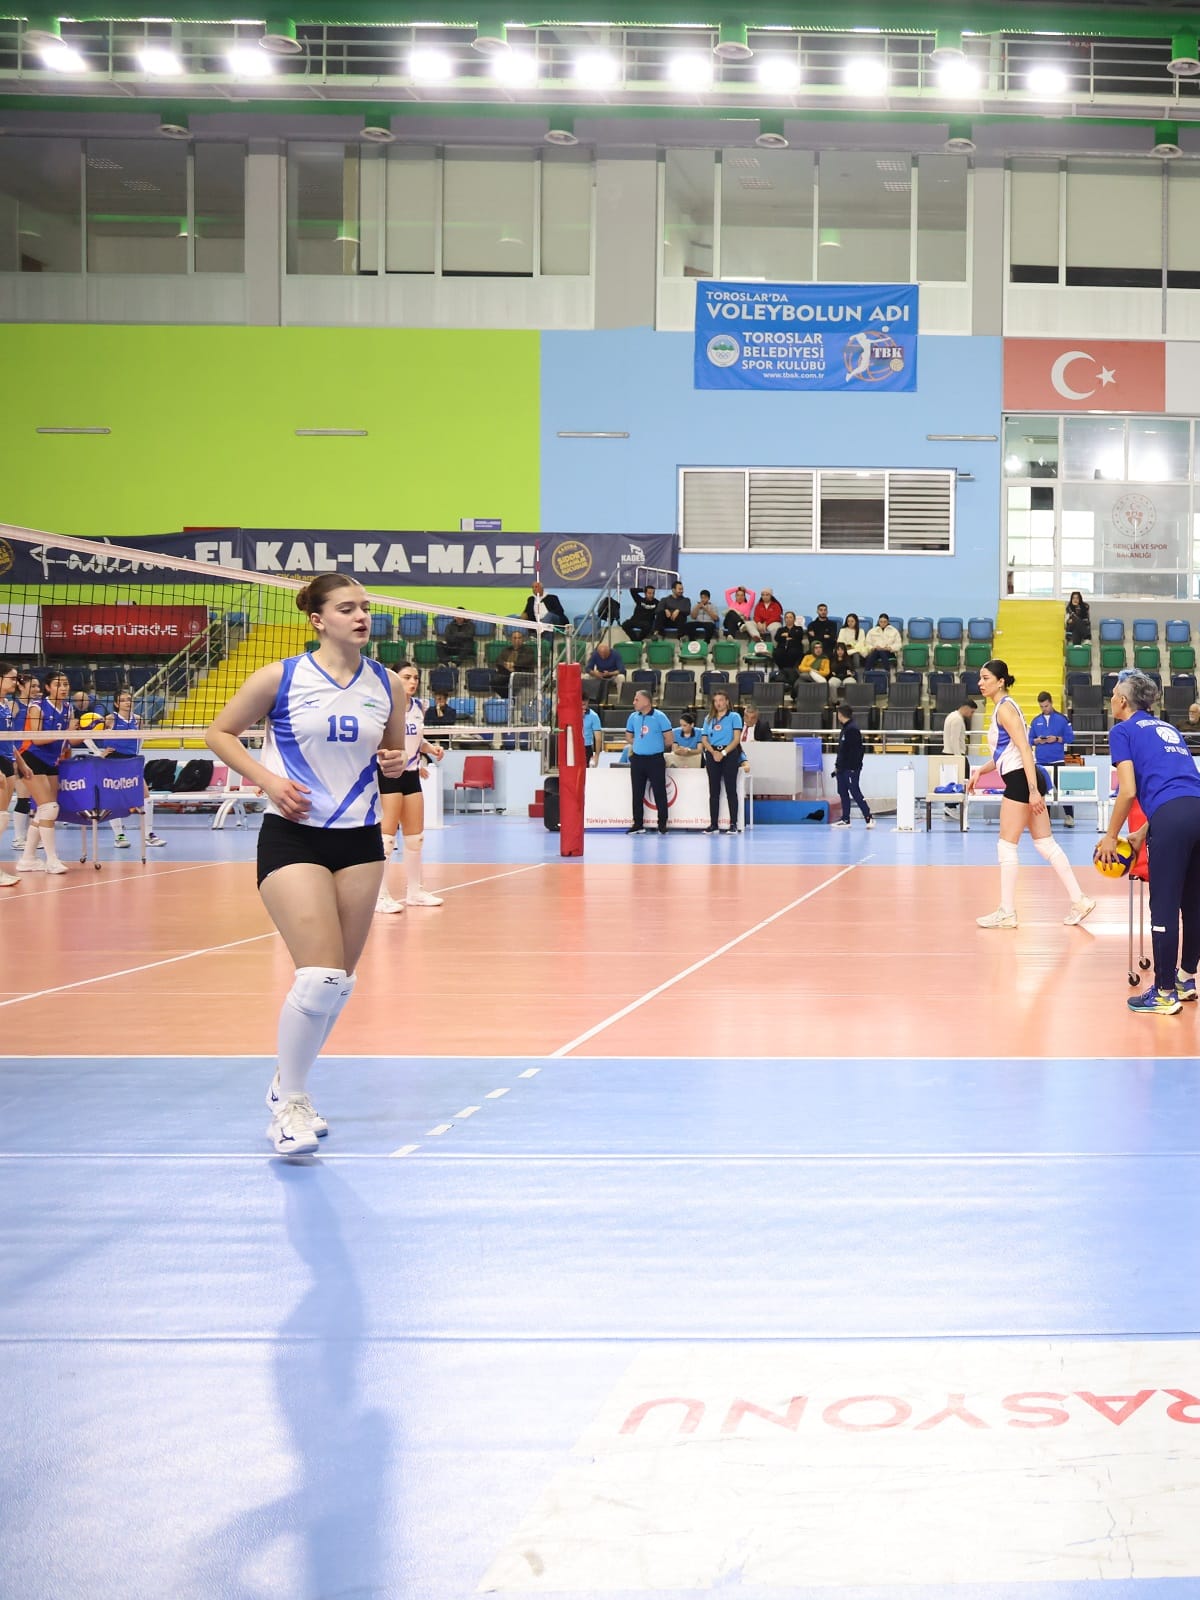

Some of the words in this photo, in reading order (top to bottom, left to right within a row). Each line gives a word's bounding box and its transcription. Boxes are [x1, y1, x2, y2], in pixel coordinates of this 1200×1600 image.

[706, 291, 788, 302] TOROSLAR'DA
[706, 303, 861, 321] VOLEYBOLUN
[869, 305, 909, 322] ADI
[742, 332, 822, 344] TOROSLAR
[743, 344, 824, 358] BELEDİYESİ
[872, 348, 902, 359] TBK
[742, 360, 773, 370] SPOR
[776, 359, 826, 371] KULÜBÜ
[195, 541, 242, 569] EL
[256, 541, 535, 575] KAL-KA-MAZ!
[326, 715, 359, 742] 19
[60, 777, 86, 791] lten
[103, 776, 139, 790] molten
